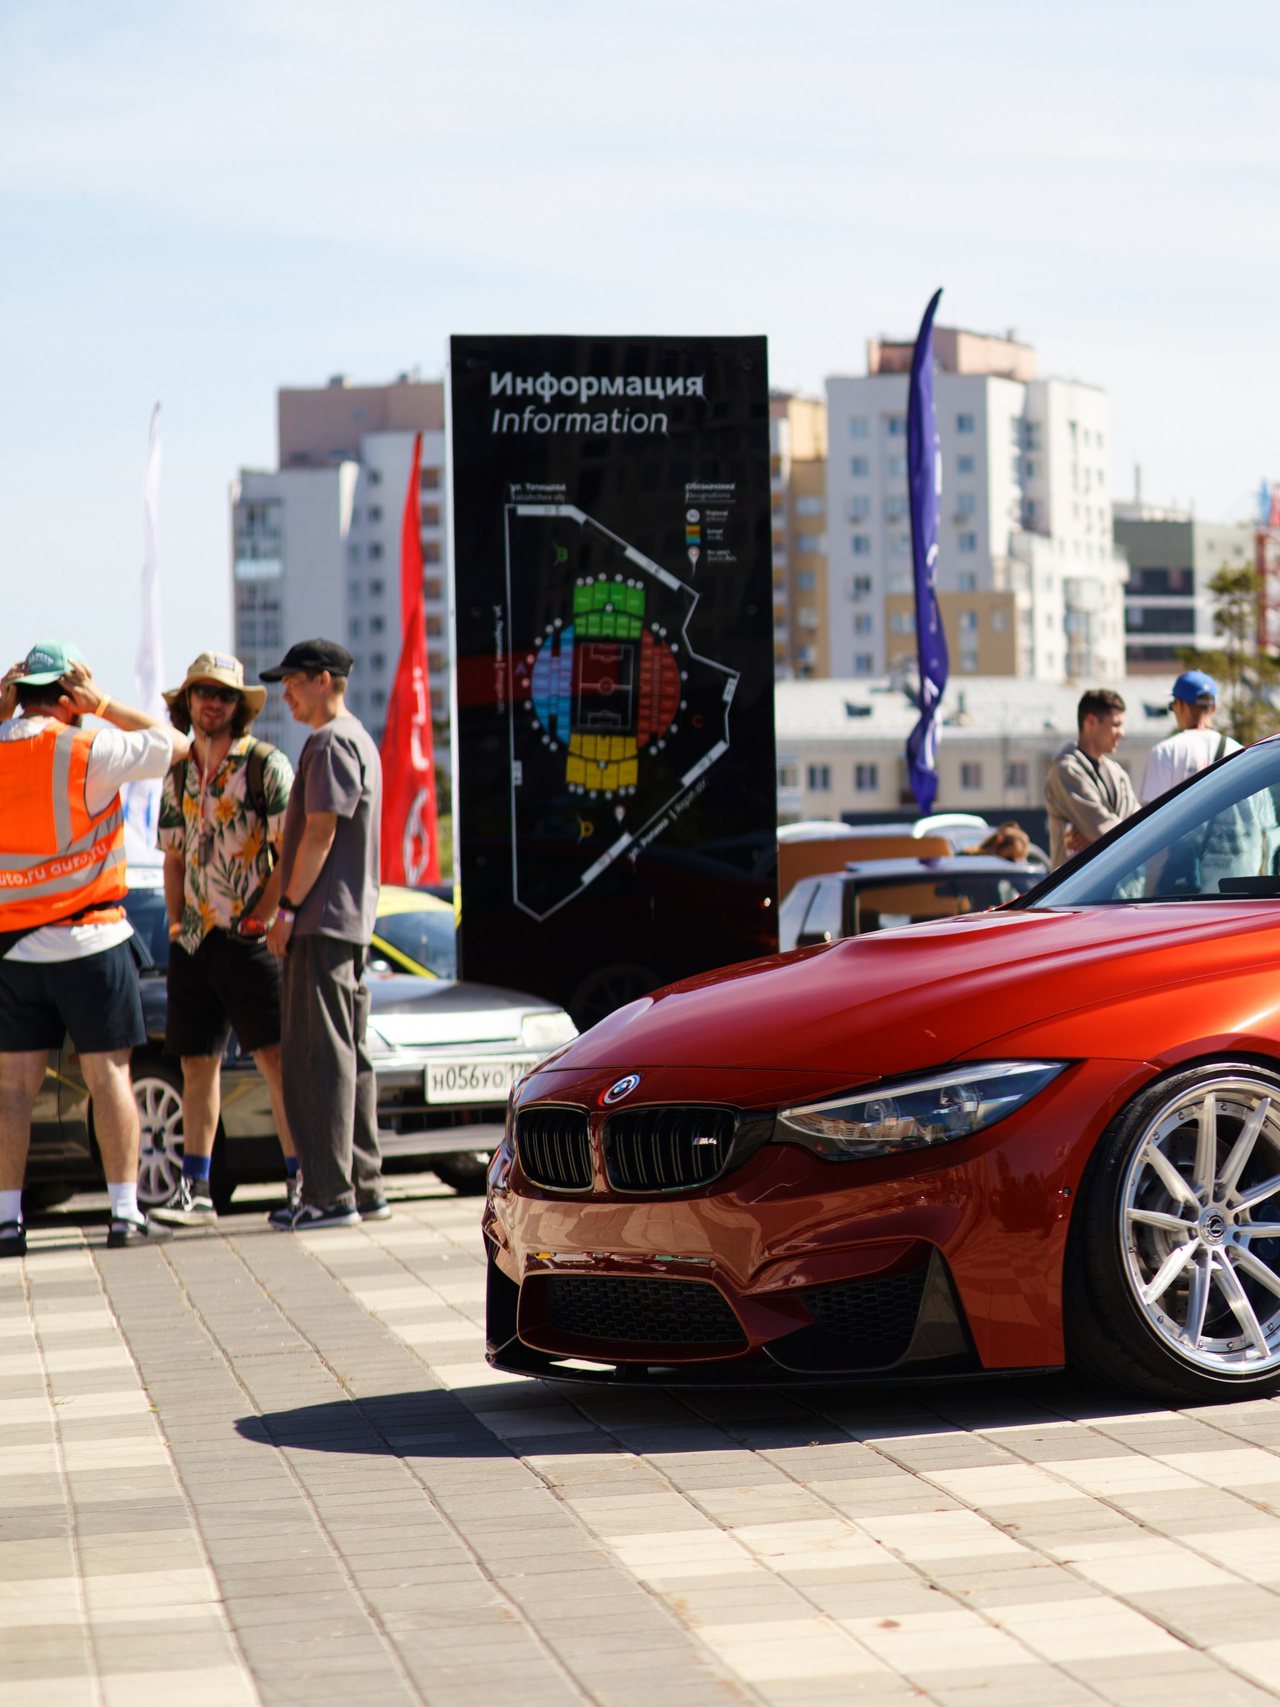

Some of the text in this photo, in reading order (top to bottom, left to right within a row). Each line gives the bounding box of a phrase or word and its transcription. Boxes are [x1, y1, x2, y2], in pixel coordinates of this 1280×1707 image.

[490, 371, 704, 404] Информация
[491, 405, 668, 434] Information
[580, 821, 594, 837] D
[698, 1137, 717, 1145] M4
